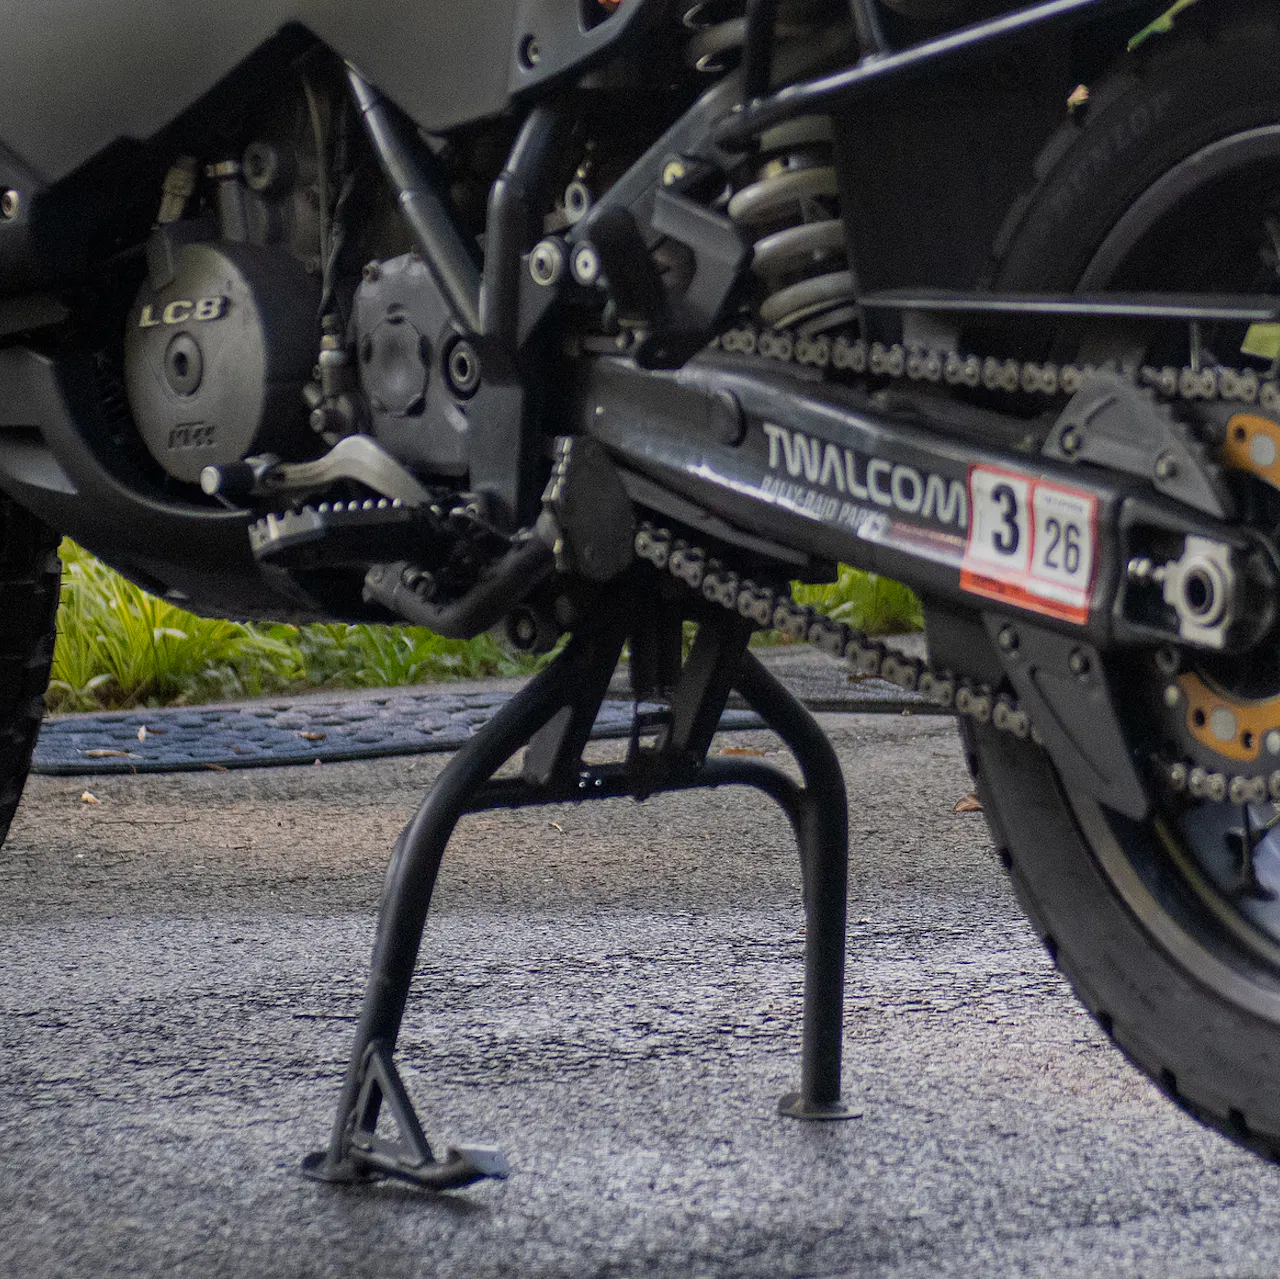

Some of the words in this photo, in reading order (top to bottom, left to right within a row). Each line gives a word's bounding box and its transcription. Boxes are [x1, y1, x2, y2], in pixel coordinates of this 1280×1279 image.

[762, 422, 969, 527] TWALCOM
[991, 482, 1020, 556] 3
[1043, 516, 1081, 575] 26
